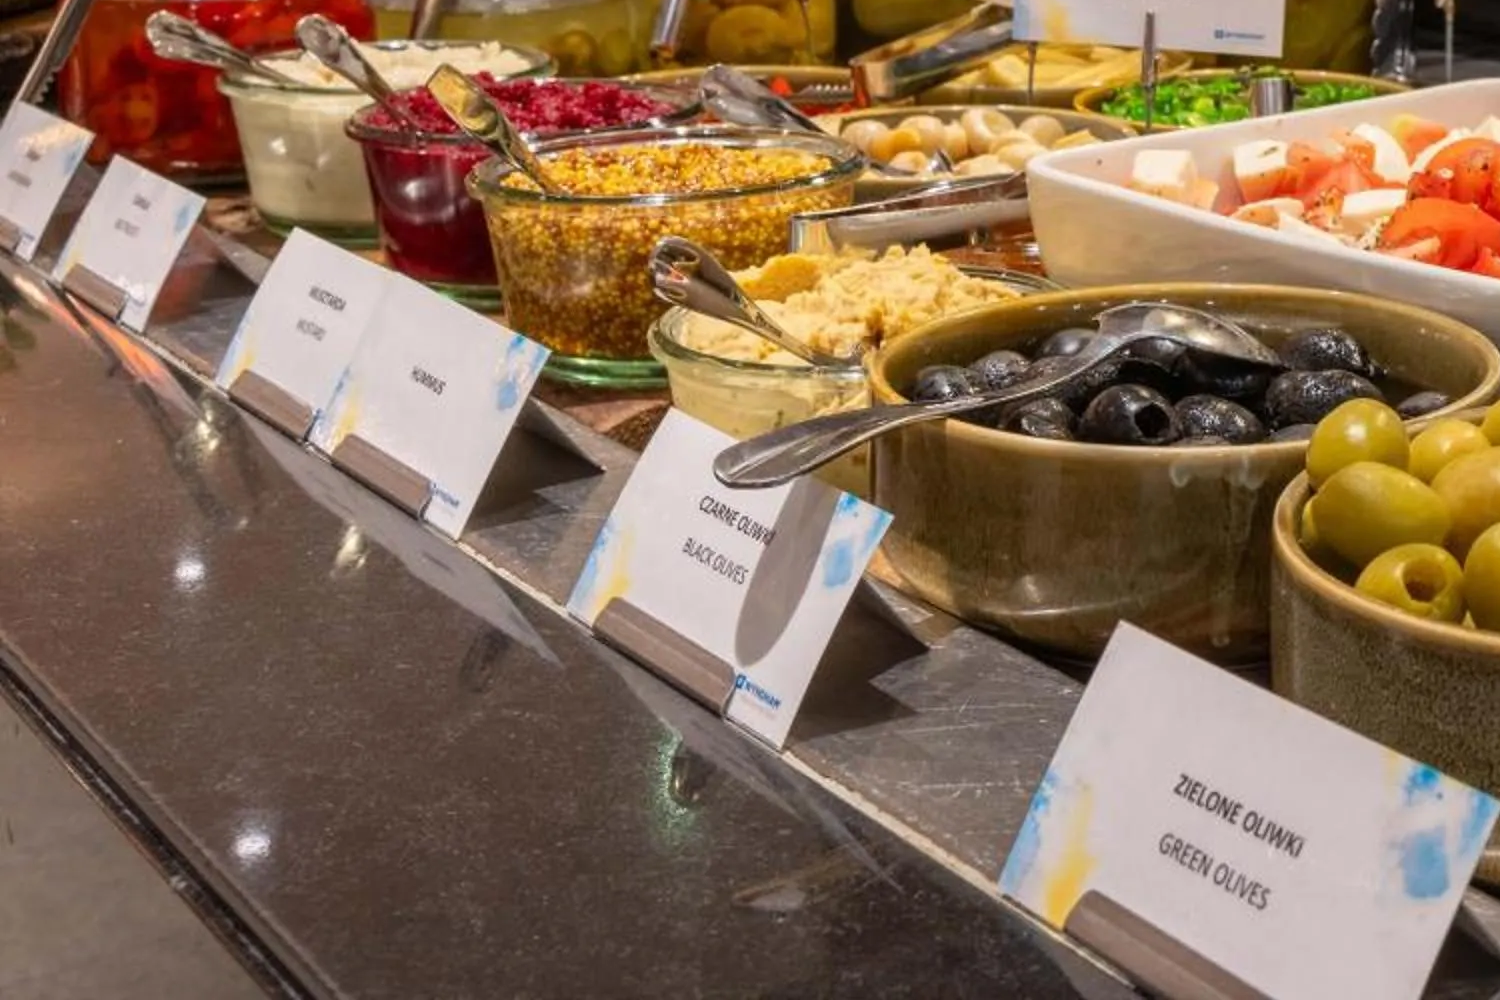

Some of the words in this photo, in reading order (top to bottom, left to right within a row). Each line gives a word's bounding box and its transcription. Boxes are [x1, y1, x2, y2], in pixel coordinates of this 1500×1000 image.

[1173, 773, 1243, 825] ZIELONE
[1242, 810, 1305, 858] OLIWKI
[1159, 832, 1213, 877] GREEN
[1213, 863, 1271, 910] OLIVES
